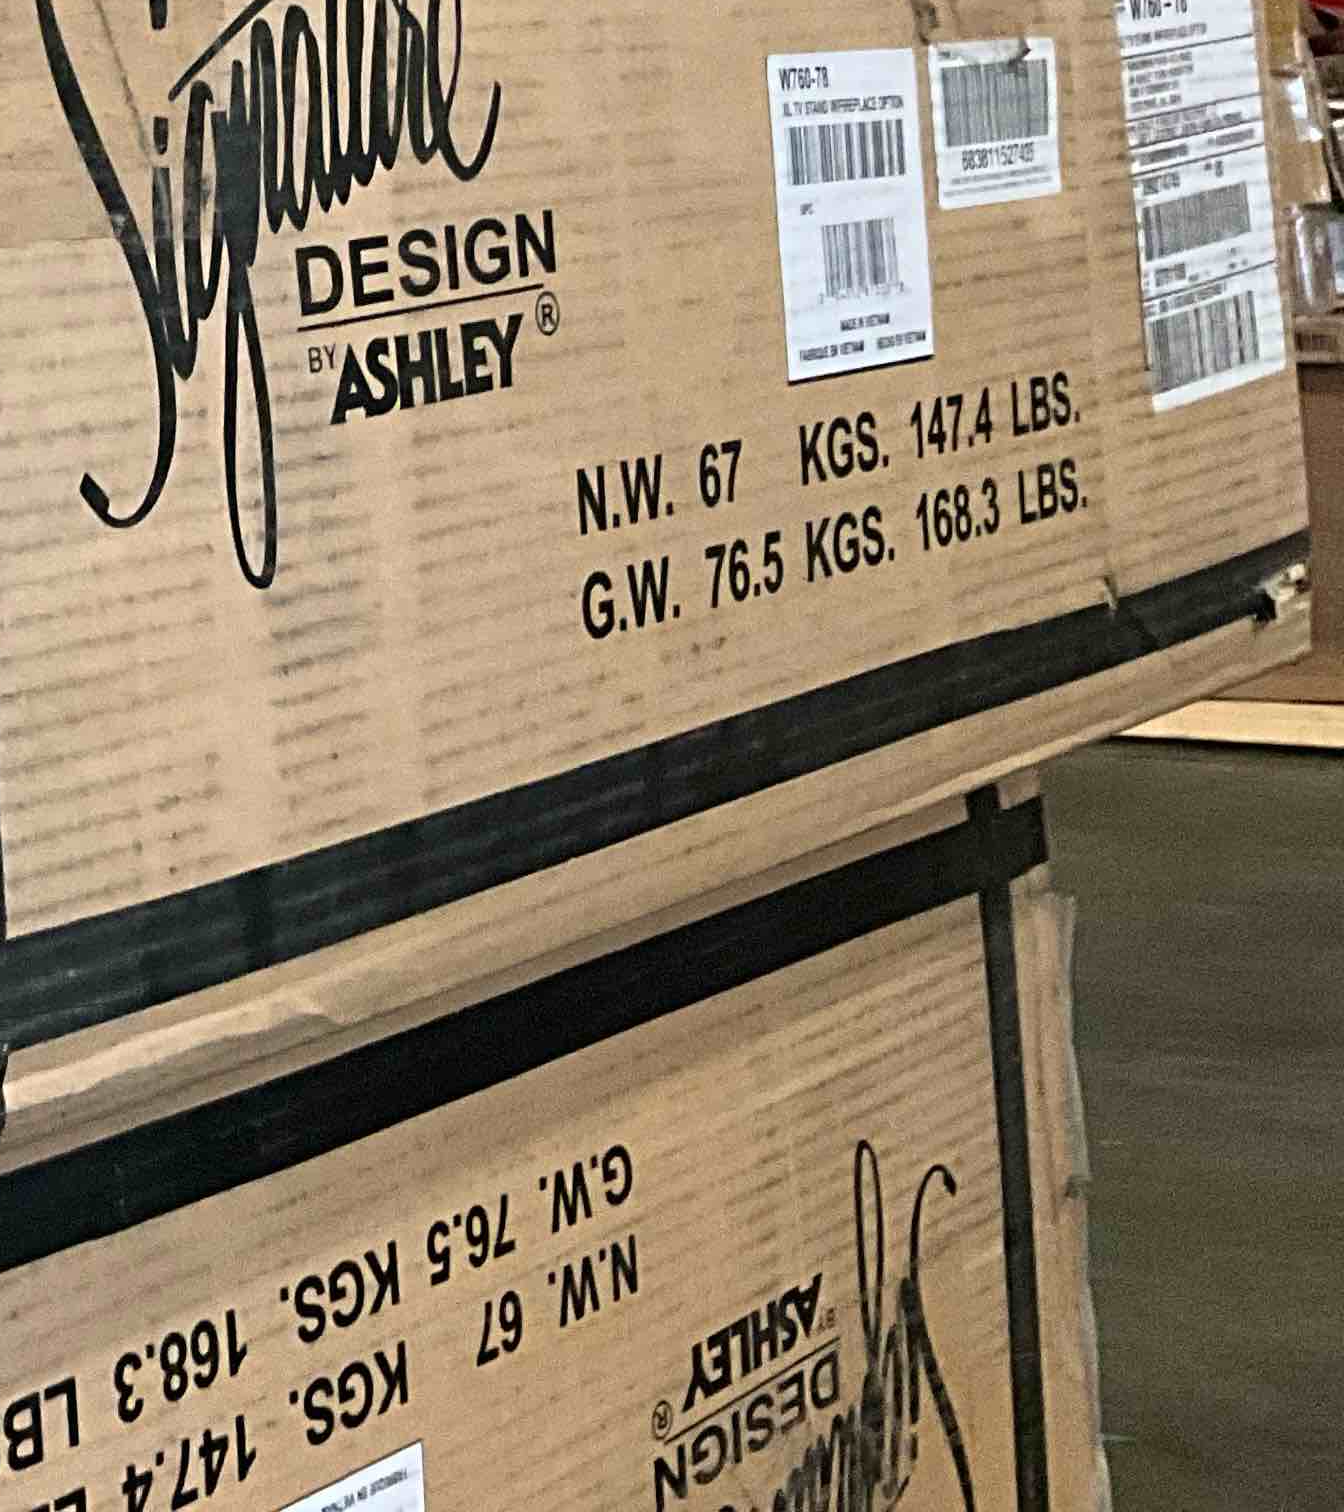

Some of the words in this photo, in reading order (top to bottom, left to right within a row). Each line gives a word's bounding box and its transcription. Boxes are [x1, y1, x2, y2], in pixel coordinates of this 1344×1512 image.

[779, 66, 829, 91] W760-78
[296, 209, 558, 316] DESIGN
[309, 347, 336, 374] BY
[331, 313, 524, 425] ASHLEY
[576, 454, 674, 536] N.W.
[699, 439, 742, 508] 67
[799, 411, 890, 486] KGS.
[910, 388, 993, 459] 147.4
[1010, 371, 1081, 436] LBS.
[581, 555, 681, 640] G.W.
[705, 530, 784, 608] 76.5
[806, 505, 895, 583] KGS.
[916, 477, 1000, 552] 168.3
[1018, 457, 1088, 524] LBS.
[426, 1193, 515, 1285] 76.5
[538, 1143, 633, 1233] G.W.
[279, 1240, 399, 1344] KGS.
[474, 1288, 522, 1367] 67
[548, 1233, 638, 1327] N.W.
[113, 1309, 248, 1423] 168.3
[289, 1341, 409, 1445] KGS.
[682, 1272, 822, 1412] ASHLEY
[121, 1414, 256, 1512] 147.4
[653, 1350, 840, 1512] DESIGN
